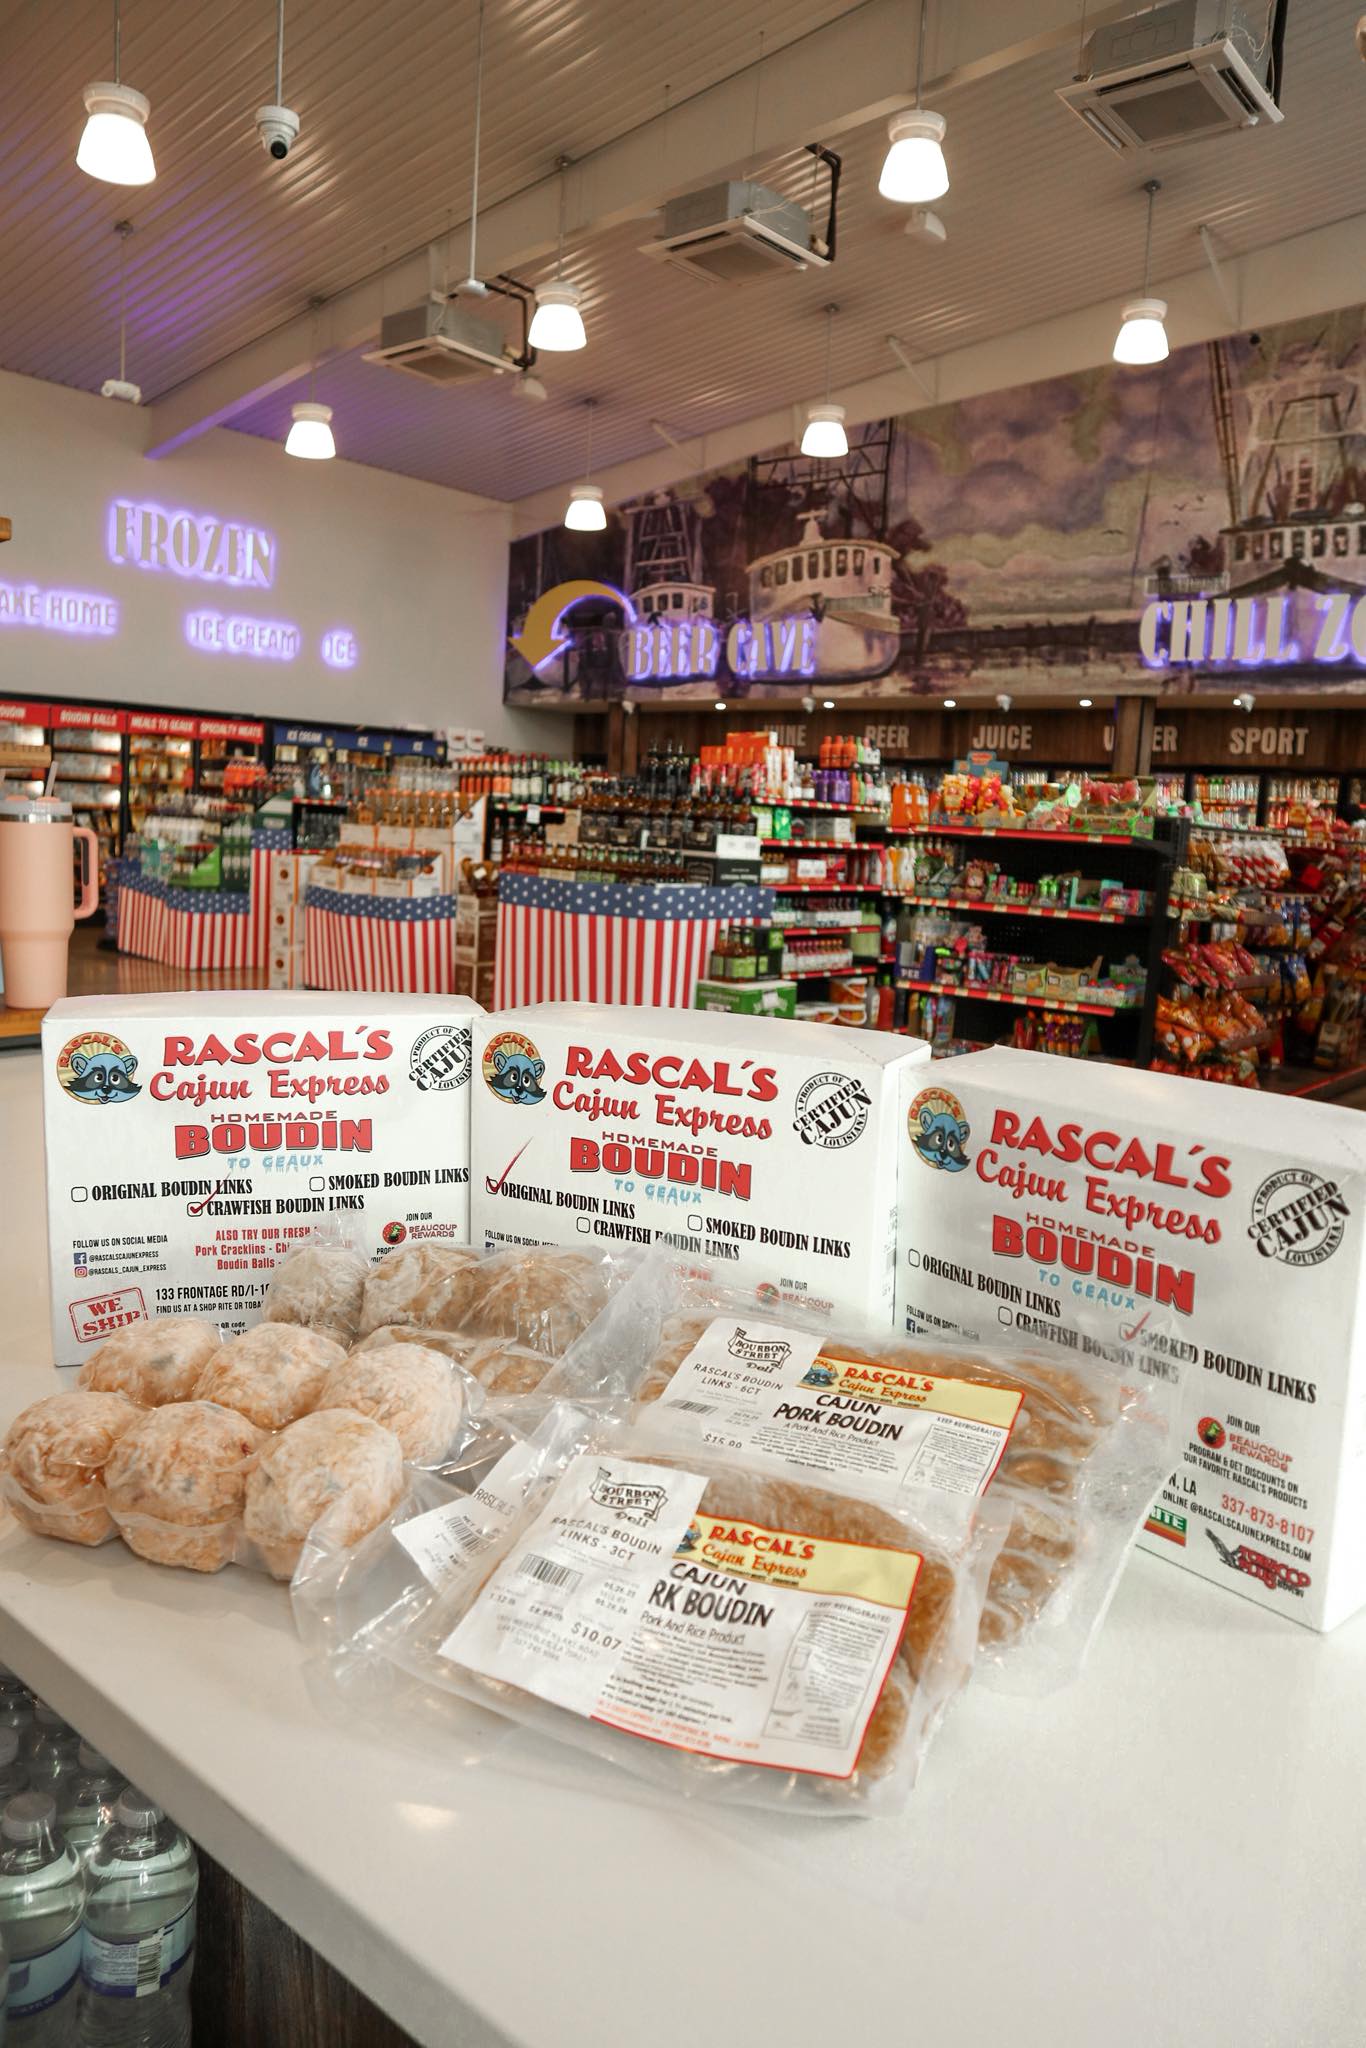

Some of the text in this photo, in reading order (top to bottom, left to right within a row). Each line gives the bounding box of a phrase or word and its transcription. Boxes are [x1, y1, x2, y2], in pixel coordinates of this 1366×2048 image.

[109, 501, 275, 587] FROZEN
[0, 583, 118, 629] AKE HOME
[187, 611, 299, 658] ICE CREAM
[1140, 597, 1299, 667] CHILL
[324, 631, 357, 665] ICE
[628, 618, 819, 679] BEER CAVE
[0, 706, 26, 719] OUDIN
[93, 713, 118, 727] BALLS
[865, 725, 909, 748] BEER
[973, 725, 1032, 751] JUICE
[1229, 726, 1309, 756] SPORT
[409, 1028, 470, 1081] CERTIFIED
[150, 1069, 390, 1107] Cajun Express
[210, 1111, 337, 1122] HOMEMADE
[552, 1080, 773, 1140] Cajun Express
[793, 1079, 862, 1131] CERTIFIED
[801, 1088, 872, 1145] CAJUN
[174, 1118, 373, 1160] BOUDIN
[602, 1131, 718, 1157] HOMEMADE
[262, 1154, 324, 1171] GEAUX
[570, 1137, 752, 1201] BOUDIN
[92, 1179, 253, 1201] ORIGINAL BOUDIN LINKS
[328, 1167, 469, 1191] SMOKED BOUDIN LINKS
[207, 1194, 365, 1216] CRAWFISH BOUDIN LINKS
[501, 1181, 635, 1219] ORIGINAL BOUDIN LINKS
[645, 1184, 701, 1205] GEAUX
[976, 1148, 1222, 1244] Cajun Express
[405, 1212, 433, 1221] JOIN OUR
[1247, 1181, 1338, 1239] CERTIFIED
[1257, 1192, 1351, 1257] CAJUN
[73, 1234, 168, 1249] FOLLOW US ON SOCIAL MEDIA
[216, 1226, 310, 1240] ALSO TRY OUR FRESH
[409, 1224, 457, 1233] BEAUCOUP
[411, 1231, 455, 1239] REWARDS
[485, 1229, 505, 1241] FOLLOW
[594, 1219, 740, 1261] CRAWFISH LINKS
[706, 1217, 851, 1259] SMOKED BOUDIN LINKS
[1026, 1212, 1156, 1258] HOMEMADE
[89, 1251, 159, 1263] @RASCALSCAJUNEXPRESS
[195, 1245, 218, 1256] Pork
[221, 1243, 265, 1255] Cracklins
[217, 1257, 275, 1270] Boudin Balls
[88, 1263, 167, 1276] @RASCALS_CAJUN_EXPRESS
[992, 1214, 1195, 1317] BOUDIN
[156, 1286, 228, 1300] 133 FRONTAGE
[780, 1278, 793, 1289] JOIN
[923, 1254, 1061, 1318] ORIGINAL BOUDIN LINKS
[1039, 1269, 1135, 1310] TO GEAUX
[88, 1297, 124, 1316] WE
[156, 1305, 171, 1314] FIND
[172, 1305, 182, 1313] US
[183, 1304, 192, 1312] AT
[199, 1303, 217, 1311] SHOP
[218, 1302, 233, 1310] RITE
[906, 1304, 925, 1320] FOLLOW
[83, 1310, 140, 1336] SHIP
[735, 1338, 787, 1354] BOURBON
[735, 1348, 779, 1360] STREET
[1016, 1311, 1179, 1384] CRAWFISH LINKS
[693, 1363, 784, 1391] RASCAL'S BOUDIN
[843, 1367, 934, 1392] RASCAL'S
[1140, 1328, 1317, 1404] SMOKED BOUDIN LINKS
[701, 1377, 733, 1389] LINKS
[839, 1379, 875, 1394] Cajun
[880, 1386, 927, 1403] Express
[816, 1394, 881, 1416] CAJUN
[773, 1403, 904, 1441] PORK BOUDIN
[1226, 1415, 1260, 1435] JOIN OUR
[848, 1432, 881, 1446] Product
[1229, 1433, 1292, 1463] BEAUCOUP
[1188, 1442, 1299, 1493] PROGRAM DISCOUNTS ON
[1231, 1443, 1288, 1473] REWARDS
[600, 1484, 661, 1499] BOURBON
[1183, 1476, 1197, 1496] LA
[1198, 1456, 1308, 1509] FAVORITE RASCAL'S PRODUCTS
[600, 1495, 652, 1507] STREET
[1163, 1490, 1312, 1562] ONLINE @RASCALSCAJUNEXPRESS.COM
[1221, 1493, 1315, 1544] 337-873-8107
[552, 1517, 662, 1555] RASCAL'S BOUDIN
[560, 1529, 599, 1548] LINKS
[610, 1545, 635, 1561] 3CT
[709, 1526, 816, 1560] RASCAL'S
[702, 1543, 745, 1565] Cajun
[751, 1555, 808, 1578] Express
[670, 1562, 747, 1595] CAJUN
[682, 1589, 775, 1628] BOUDIN
[641, 1610, 746, 1646] Pork Rice Product
